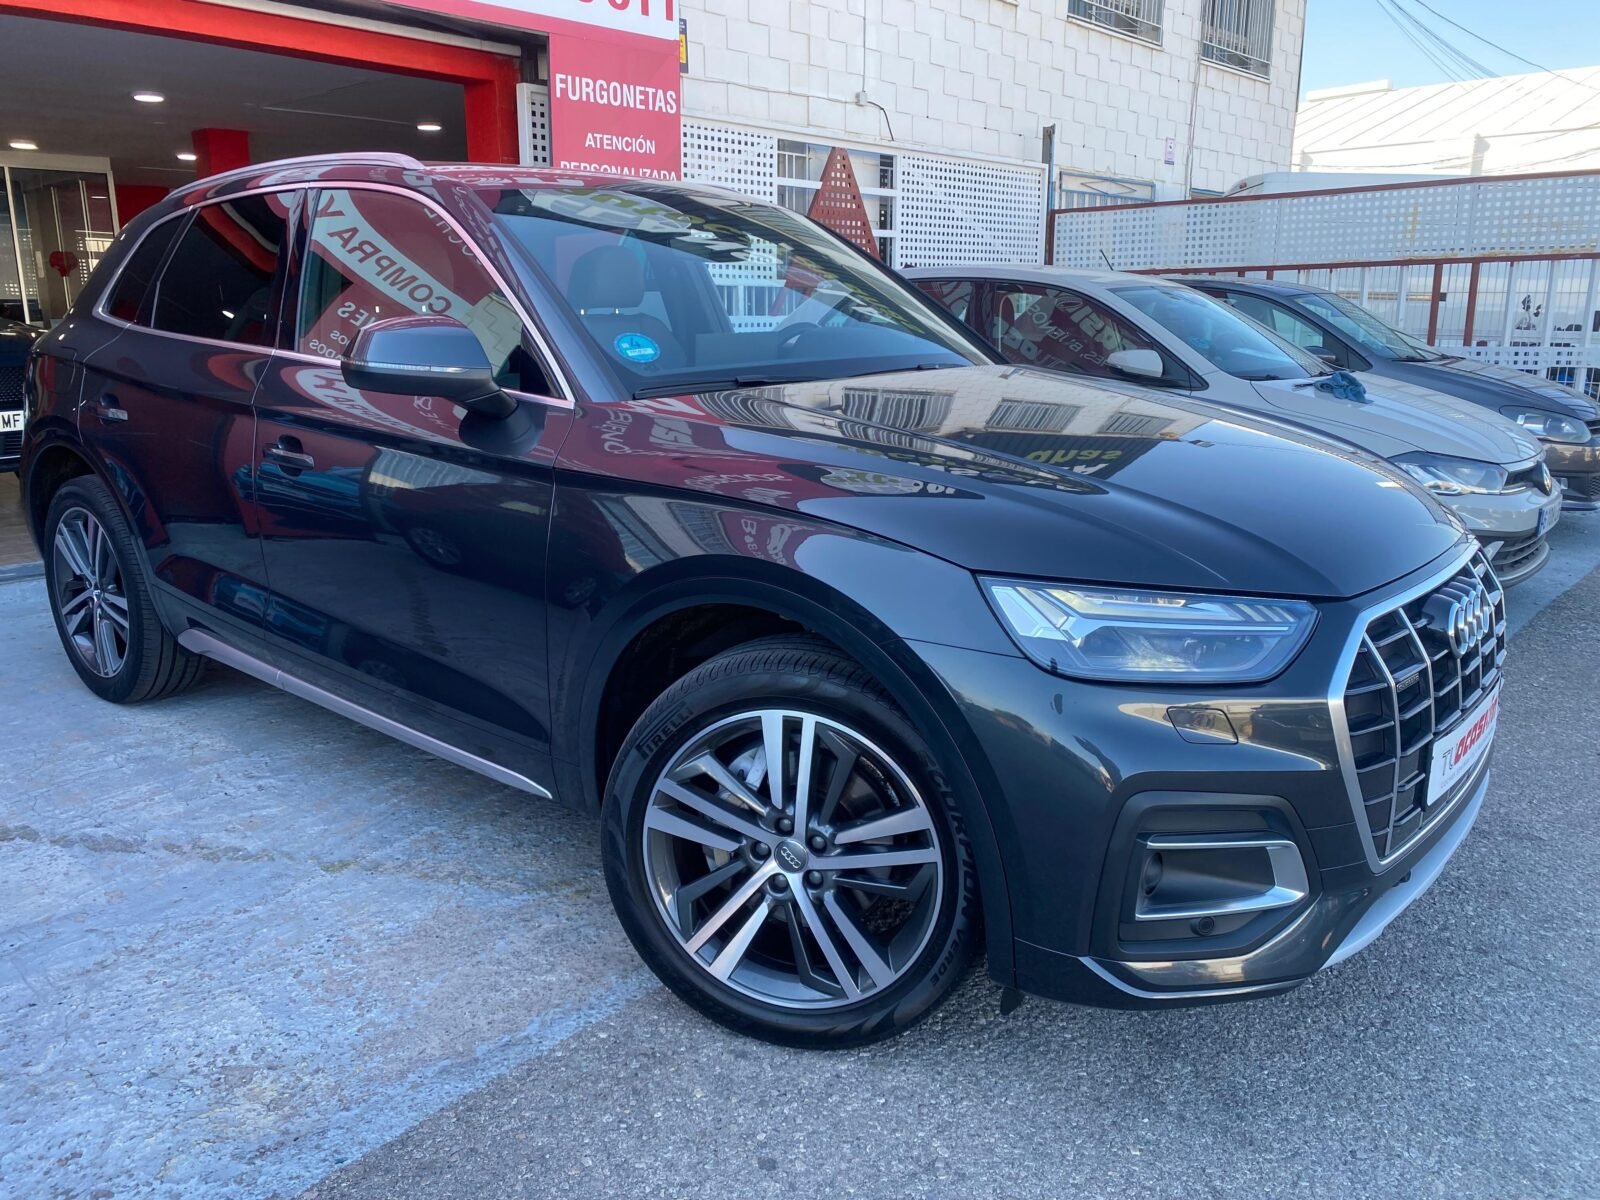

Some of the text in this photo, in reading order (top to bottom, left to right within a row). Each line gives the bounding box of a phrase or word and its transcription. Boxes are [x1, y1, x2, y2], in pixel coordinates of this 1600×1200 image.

[555, 73, 677, 114] FURGONETAS
[585, 132, 656, 154] ATENCIÓN
[1, 413, 21, 429] MF
[634, 700, 694, 760] PIRELLI
[926, 751, 978, 987] CORPION VERDE
